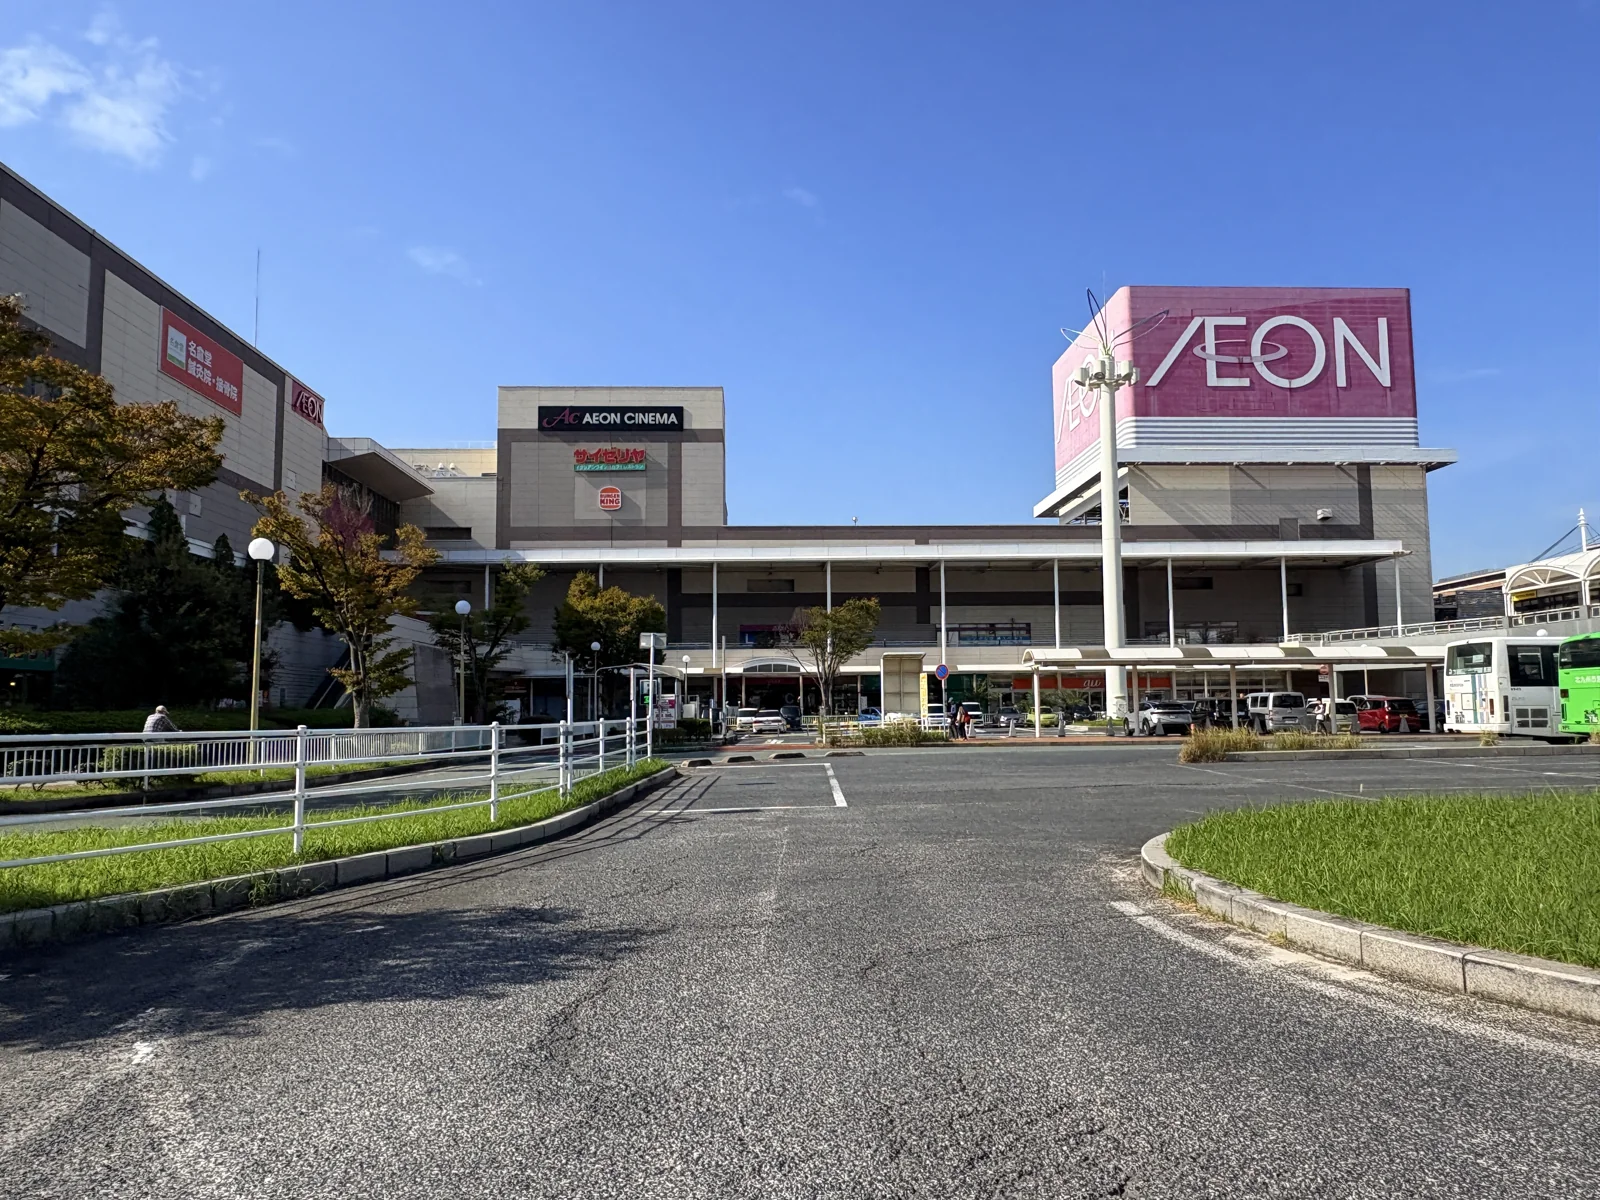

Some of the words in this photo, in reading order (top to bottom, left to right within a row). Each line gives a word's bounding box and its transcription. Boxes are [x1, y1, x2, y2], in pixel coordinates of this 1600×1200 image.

[582, 412, 621, 425] AEON
[624, 412, 679, 425] CINEMA
[574, 446, 646, 464] サイゼリヤ
[1083, 679, 1101, 691] au
